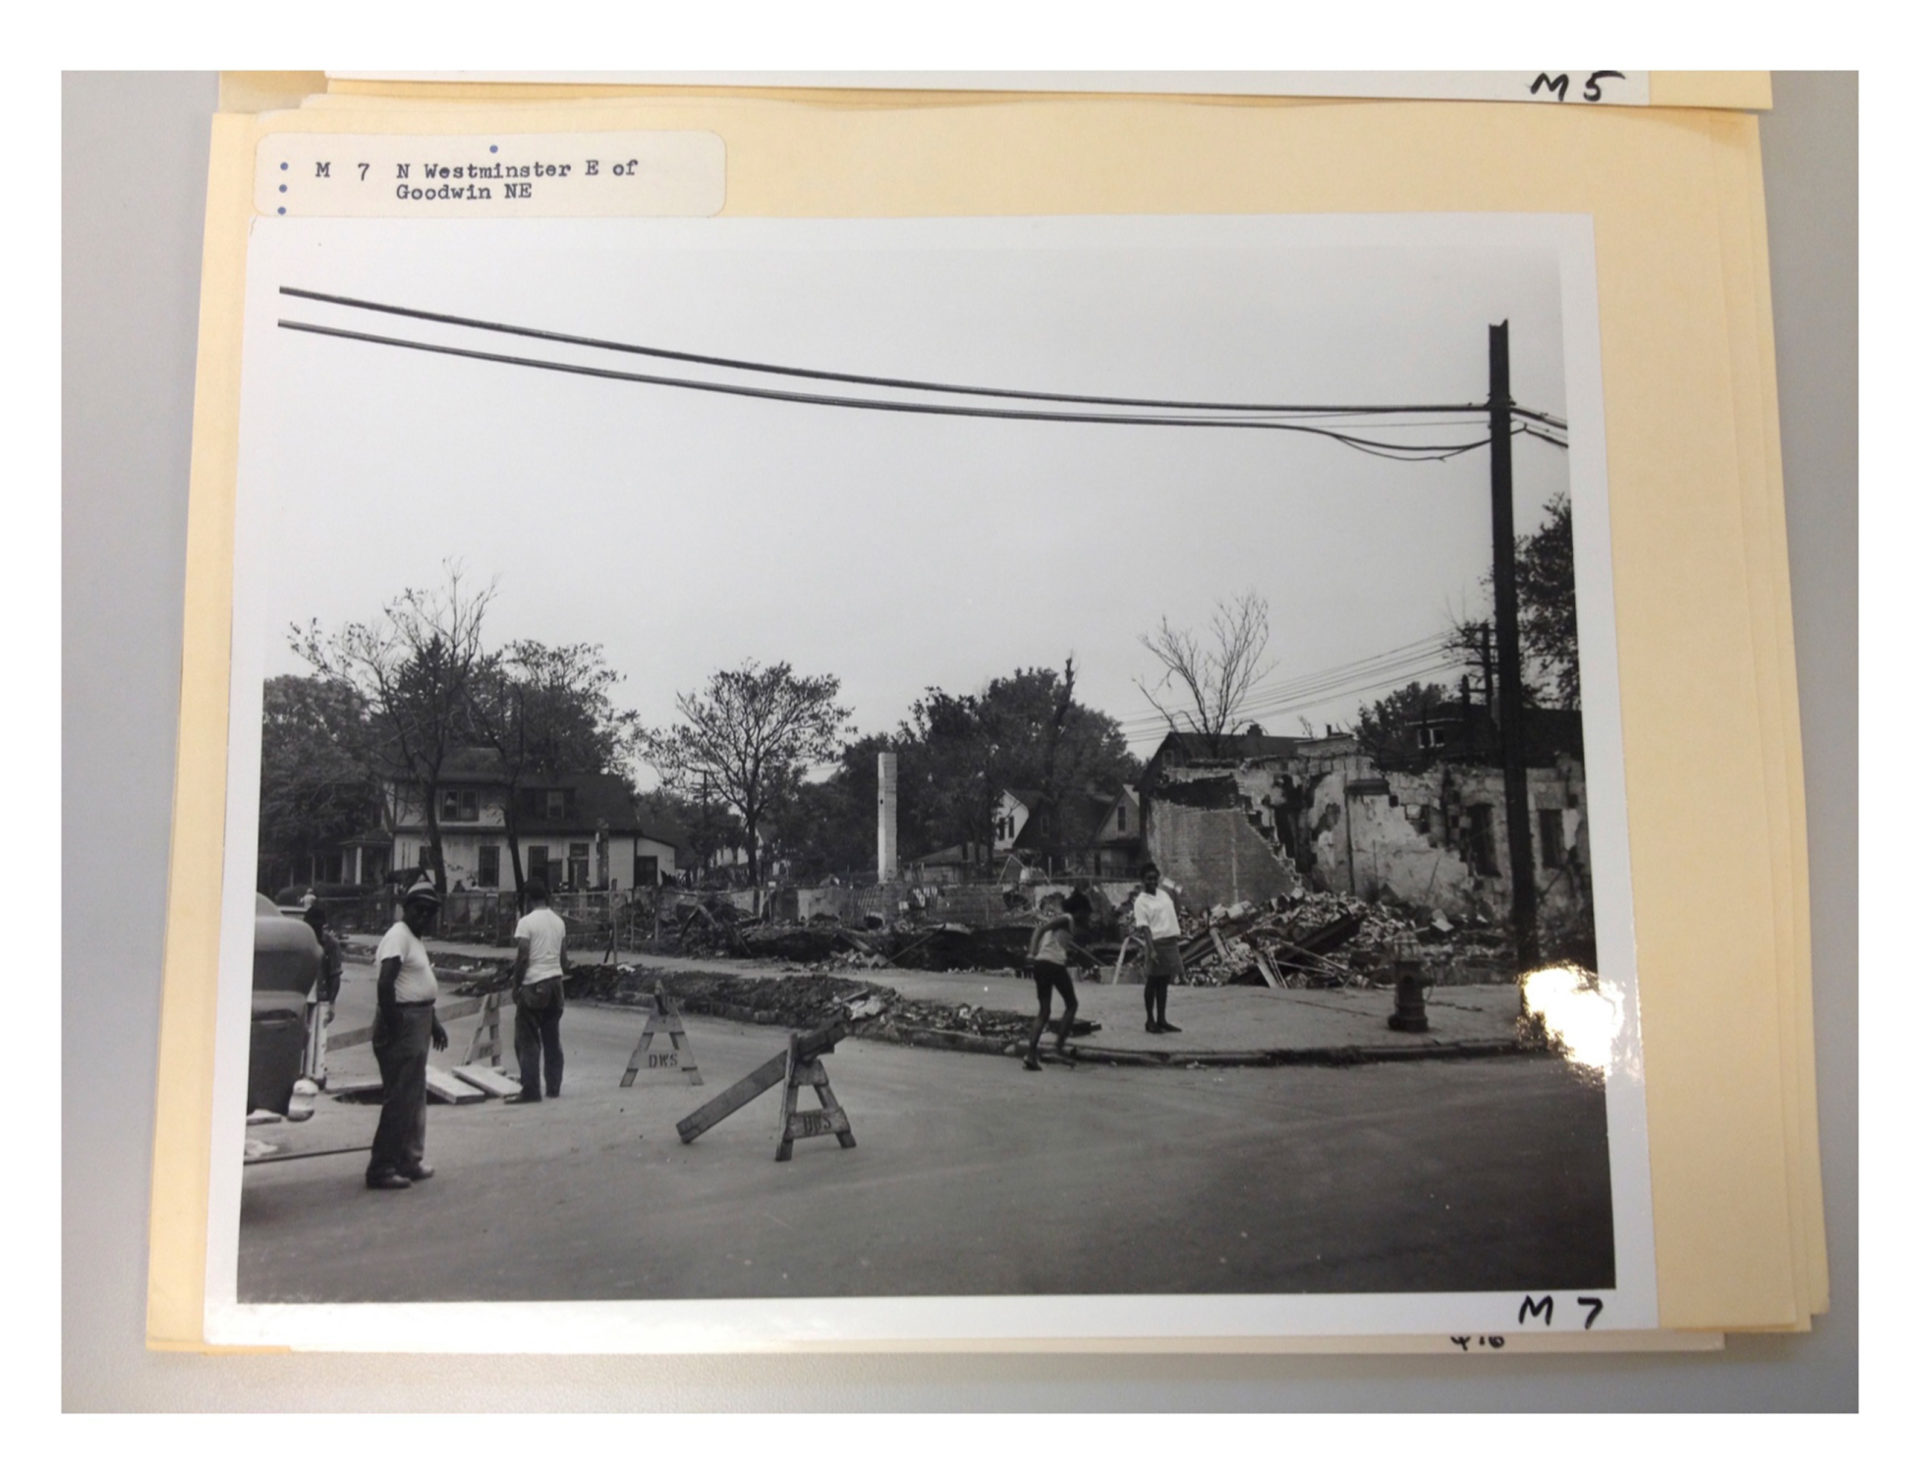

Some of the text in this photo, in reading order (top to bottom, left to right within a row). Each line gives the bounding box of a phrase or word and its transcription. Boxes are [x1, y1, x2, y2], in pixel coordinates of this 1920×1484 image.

[1530, 70, 1626, 102] M 5
[315, 159, 639, 181] M 7 N Westminster E of
[396, 182, 533, 200] Goodwin NE
[1518, 1294, 1604, 1330] M 7
